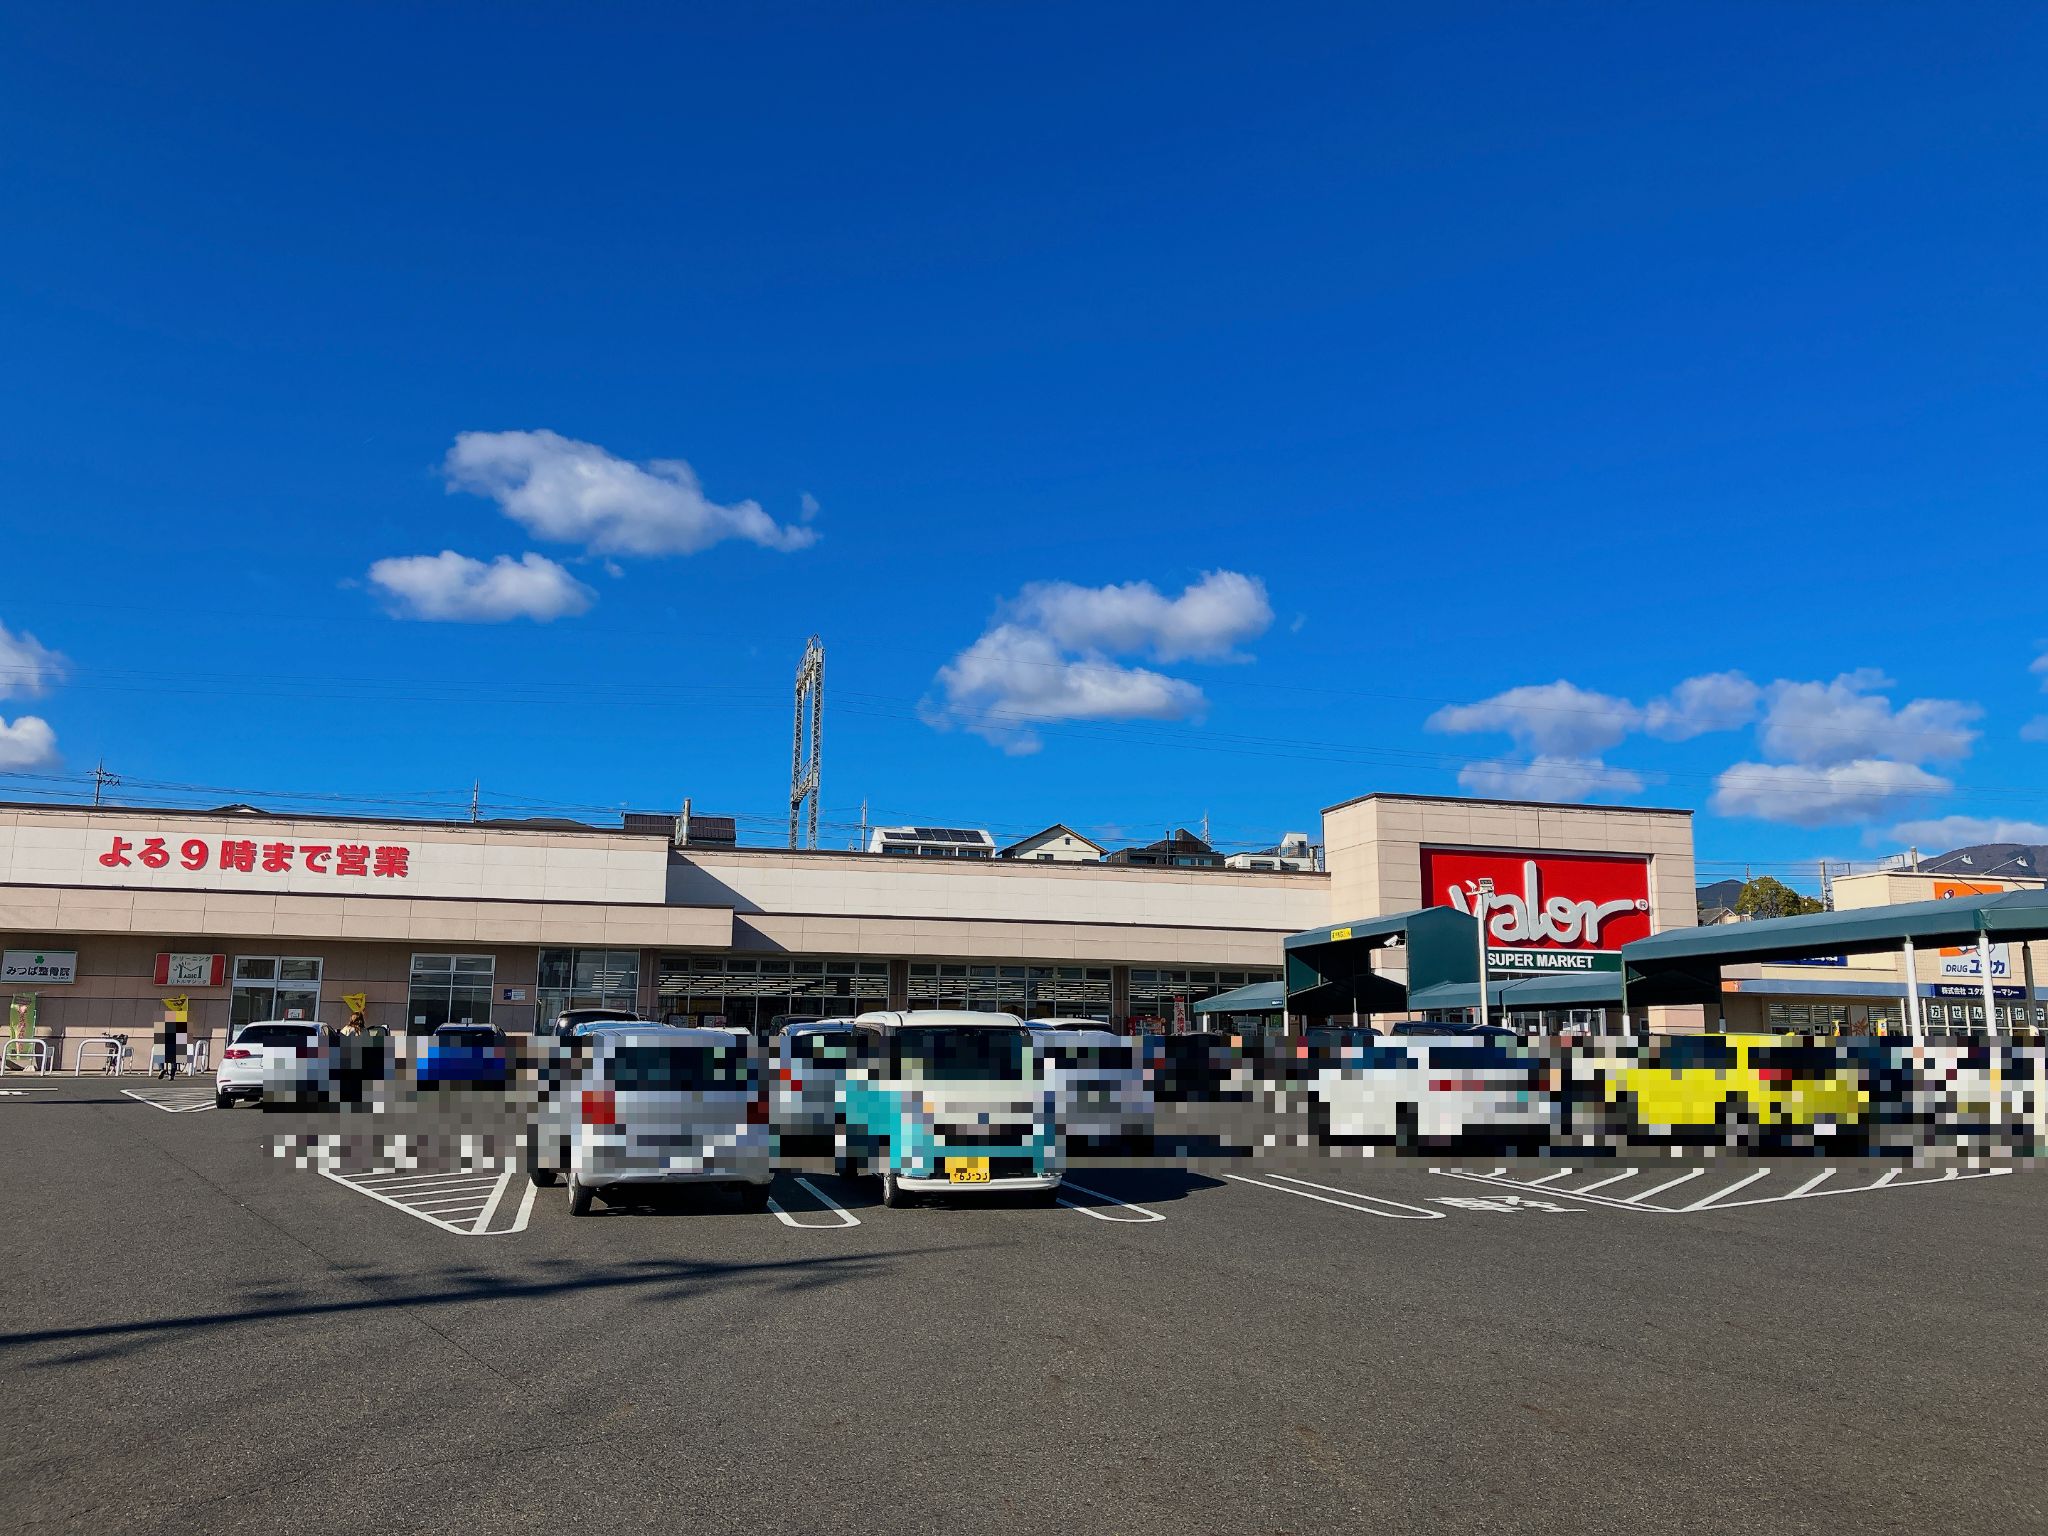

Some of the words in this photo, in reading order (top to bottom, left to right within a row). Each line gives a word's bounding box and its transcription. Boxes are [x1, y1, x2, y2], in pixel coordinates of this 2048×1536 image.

[99, 836, 410, 878] よる9時まで営業
[1487, 952, 1535, 967] SUPER
[1536, 954, 1594, 969] MARKET
[1945, 964, 1968, 973] DRUG
[1969, 959, 2006, 975] ユカ
[1941, 987, 1967, 995] 株式会社
